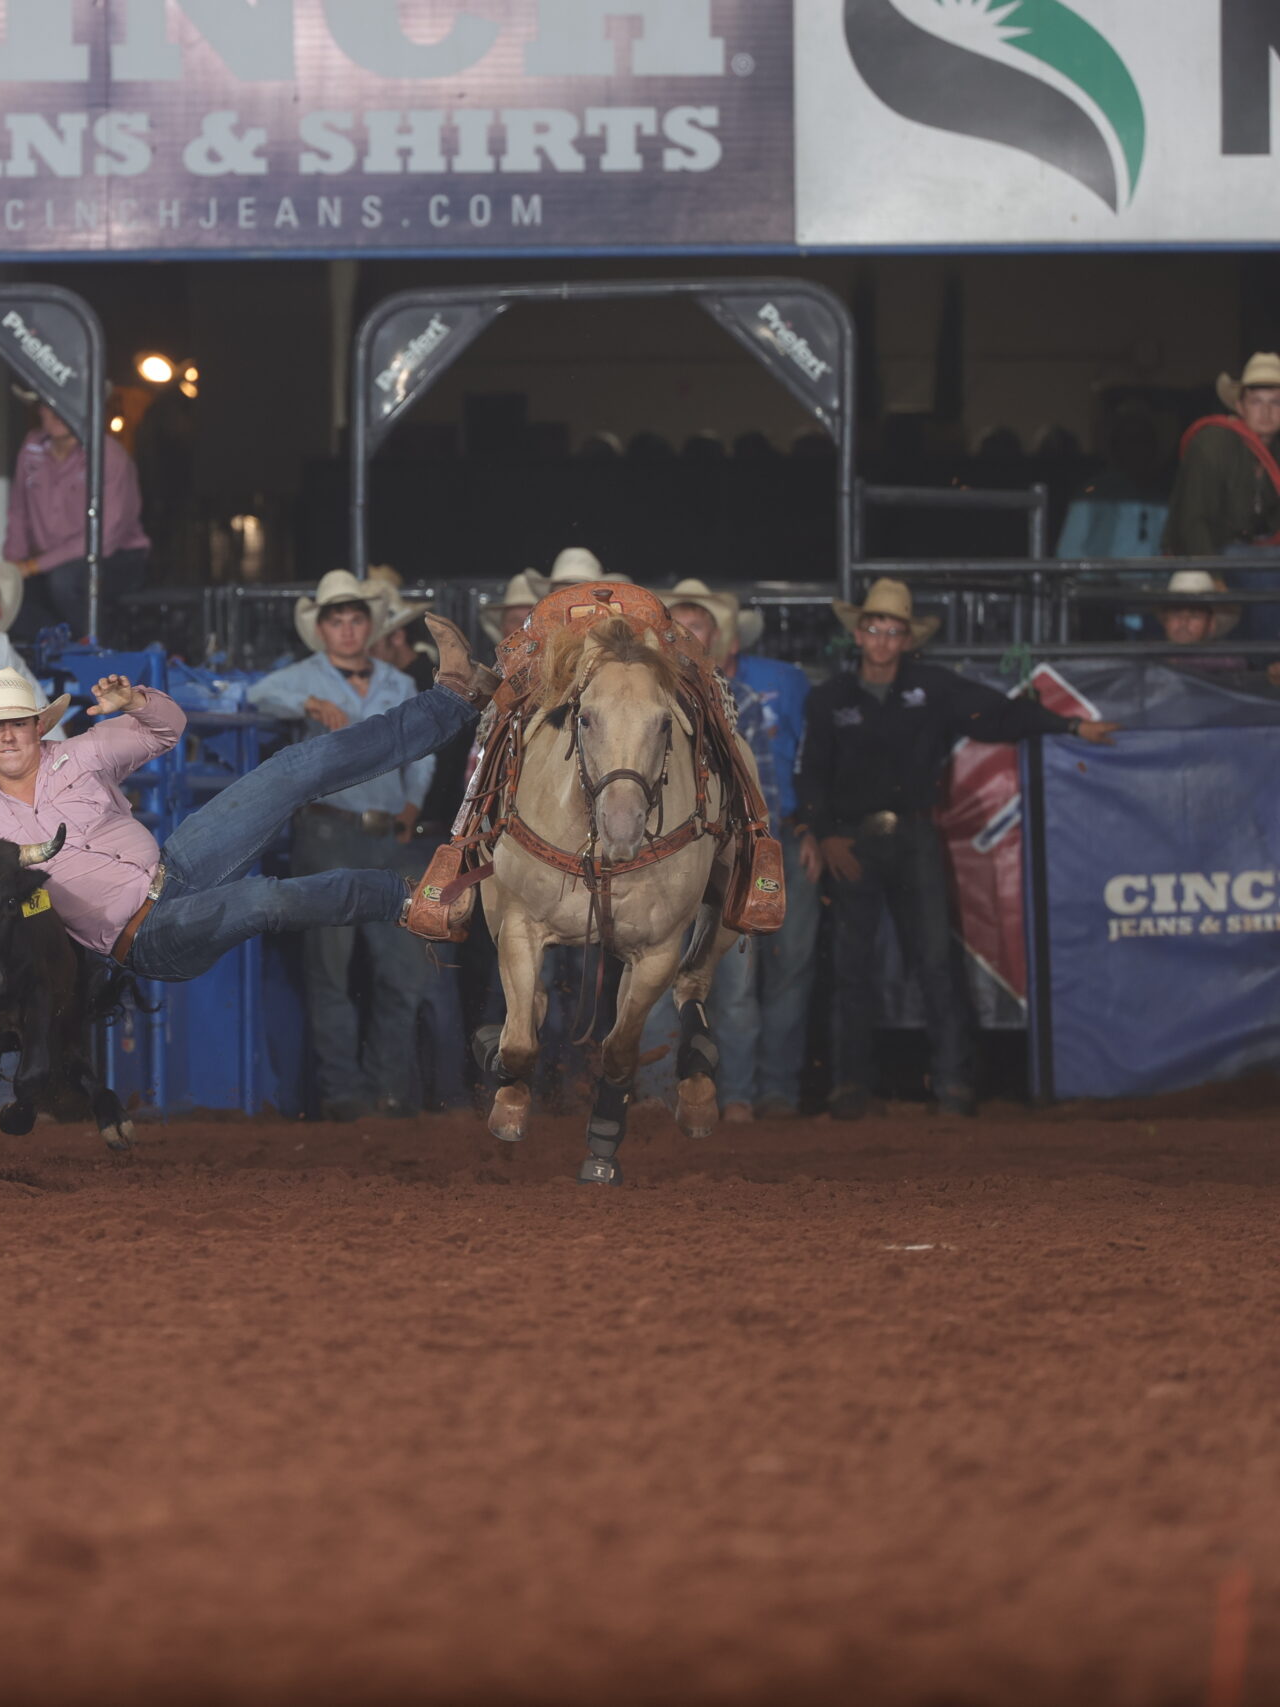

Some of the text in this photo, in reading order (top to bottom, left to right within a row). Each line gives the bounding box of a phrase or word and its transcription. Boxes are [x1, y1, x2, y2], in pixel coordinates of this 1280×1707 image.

[183, 110, 268, 177] &
[299, 105, 723, 175] SHIRTS
[5, 194, 543, 231] CINCHJEANS.COM
[1, 310, 72, 388] Priefert
[375, 318, 451, 392] Prefert
[1104, 870, 1280, 916] CINC
[1108, 912, 1280, 942] JEANS & SHI
